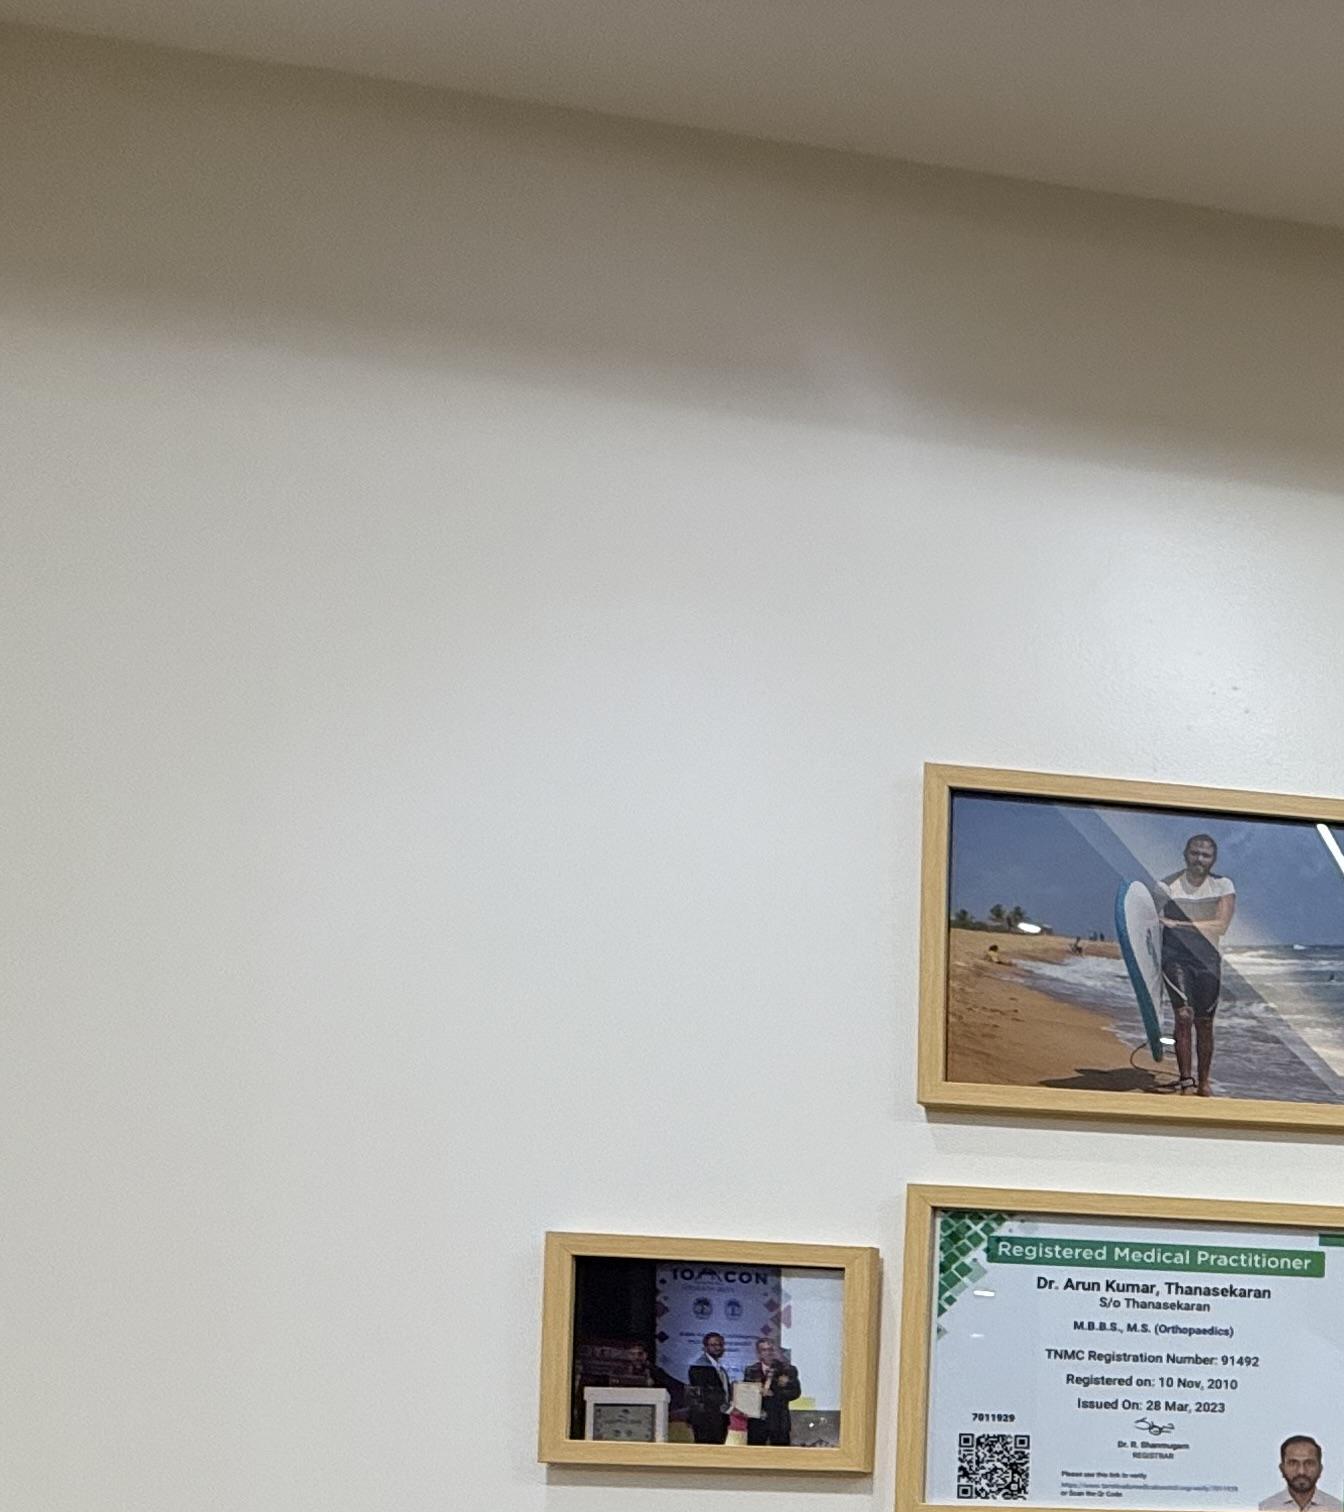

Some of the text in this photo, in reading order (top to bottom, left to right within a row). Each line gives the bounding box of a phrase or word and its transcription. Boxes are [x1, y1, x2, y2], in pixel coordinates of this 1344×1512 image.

[998, 1242, 1312, 1271] Registered Medical Practitioner
[1036, 1277, 1271, 1299] Dr. Arun Kumar, Thanasekaran
[1099, 1297, 1210, 1312] S/o Thanasekaran
[1127, 1322, 1151, 1333] M.S.
[1154, 1323, 1234, 1339] (Orthopaedics)
[1045, 1349, 1260, 1368] TNMC Registration Number: 91492
[1066, 1374, 1238, 1391] Registered on: 10 Nov, 2010
[1078, 1398, 1225, 1414] Issued On: 28 Mar, 2023
